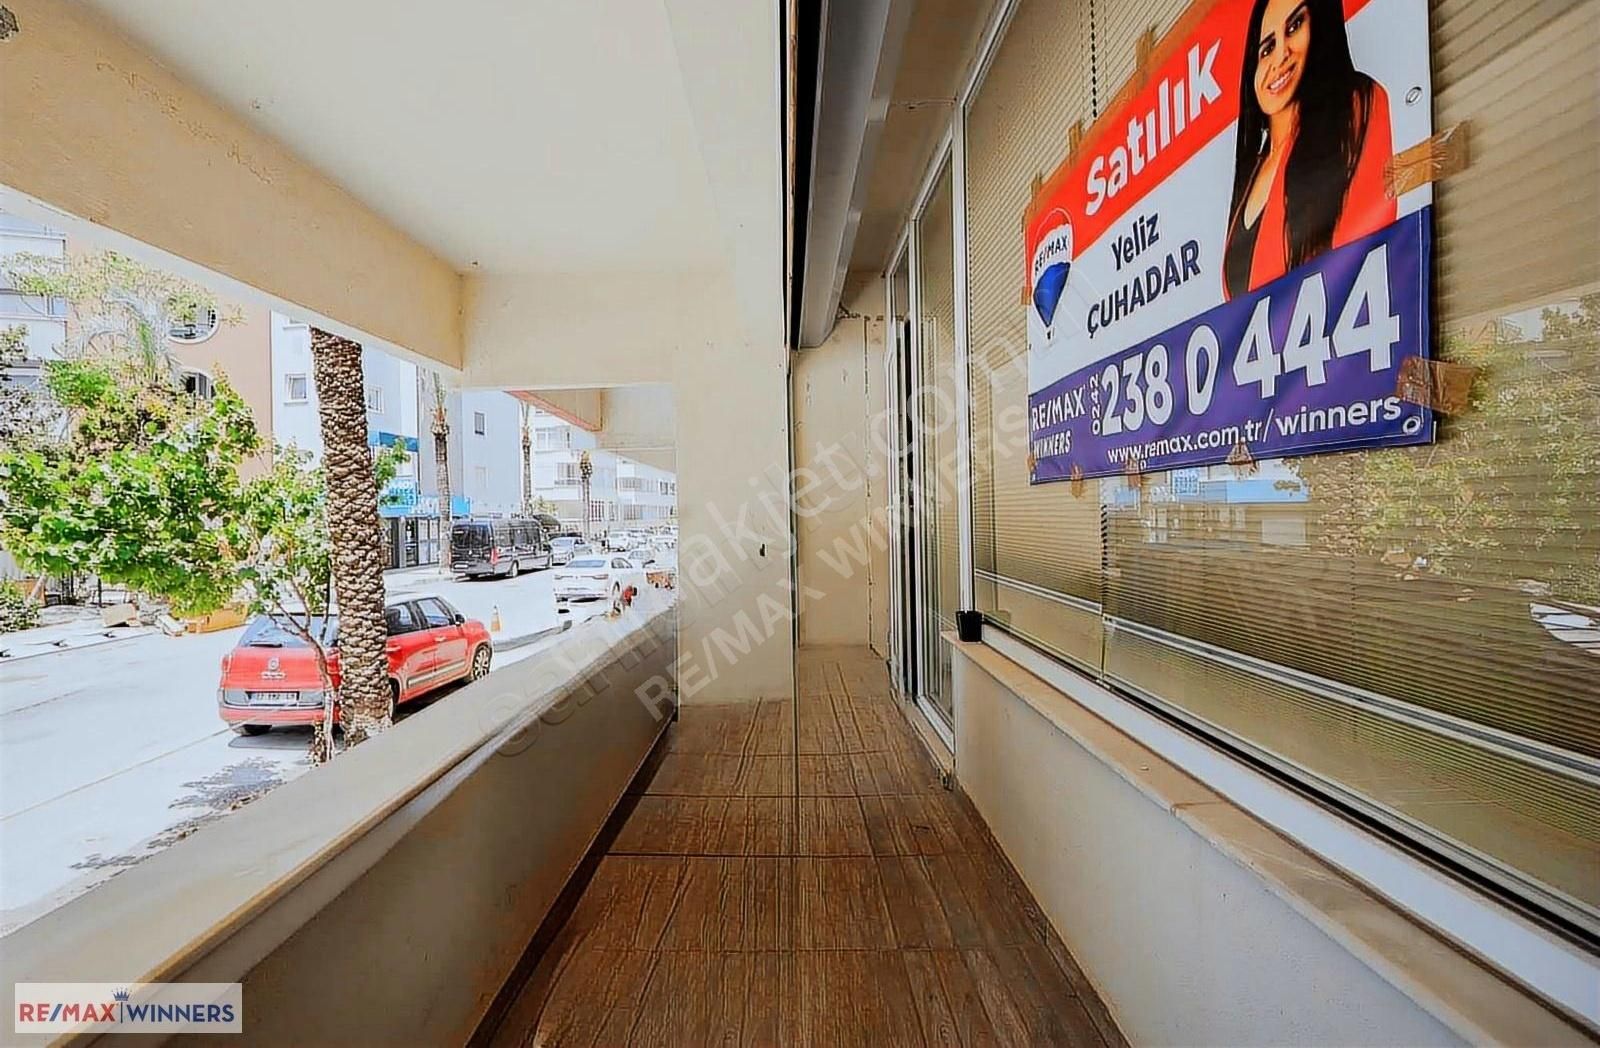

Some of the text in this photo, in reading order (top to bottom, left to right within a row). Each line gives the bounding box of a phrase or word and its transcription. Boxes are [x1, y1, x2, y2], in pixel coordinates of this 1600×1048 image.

[1085, 38, 1223, 216] Satılık
[1034, 235, 1068, 277] RE/MAX
[1111, 212, 1160, 271] Yeliz
[1087, 239, 1200, 339] ÇUHADAR
[1102, 244, 1400, 437] 238 0 444
[1032, 385, 1086, 432] RE/MAX
[1089, 373, 1101, 436] 0242
[1107, 396, 1402, 465] www.remax.com.tr/winners
[1033, 430, 1072, 460] WINNERS
